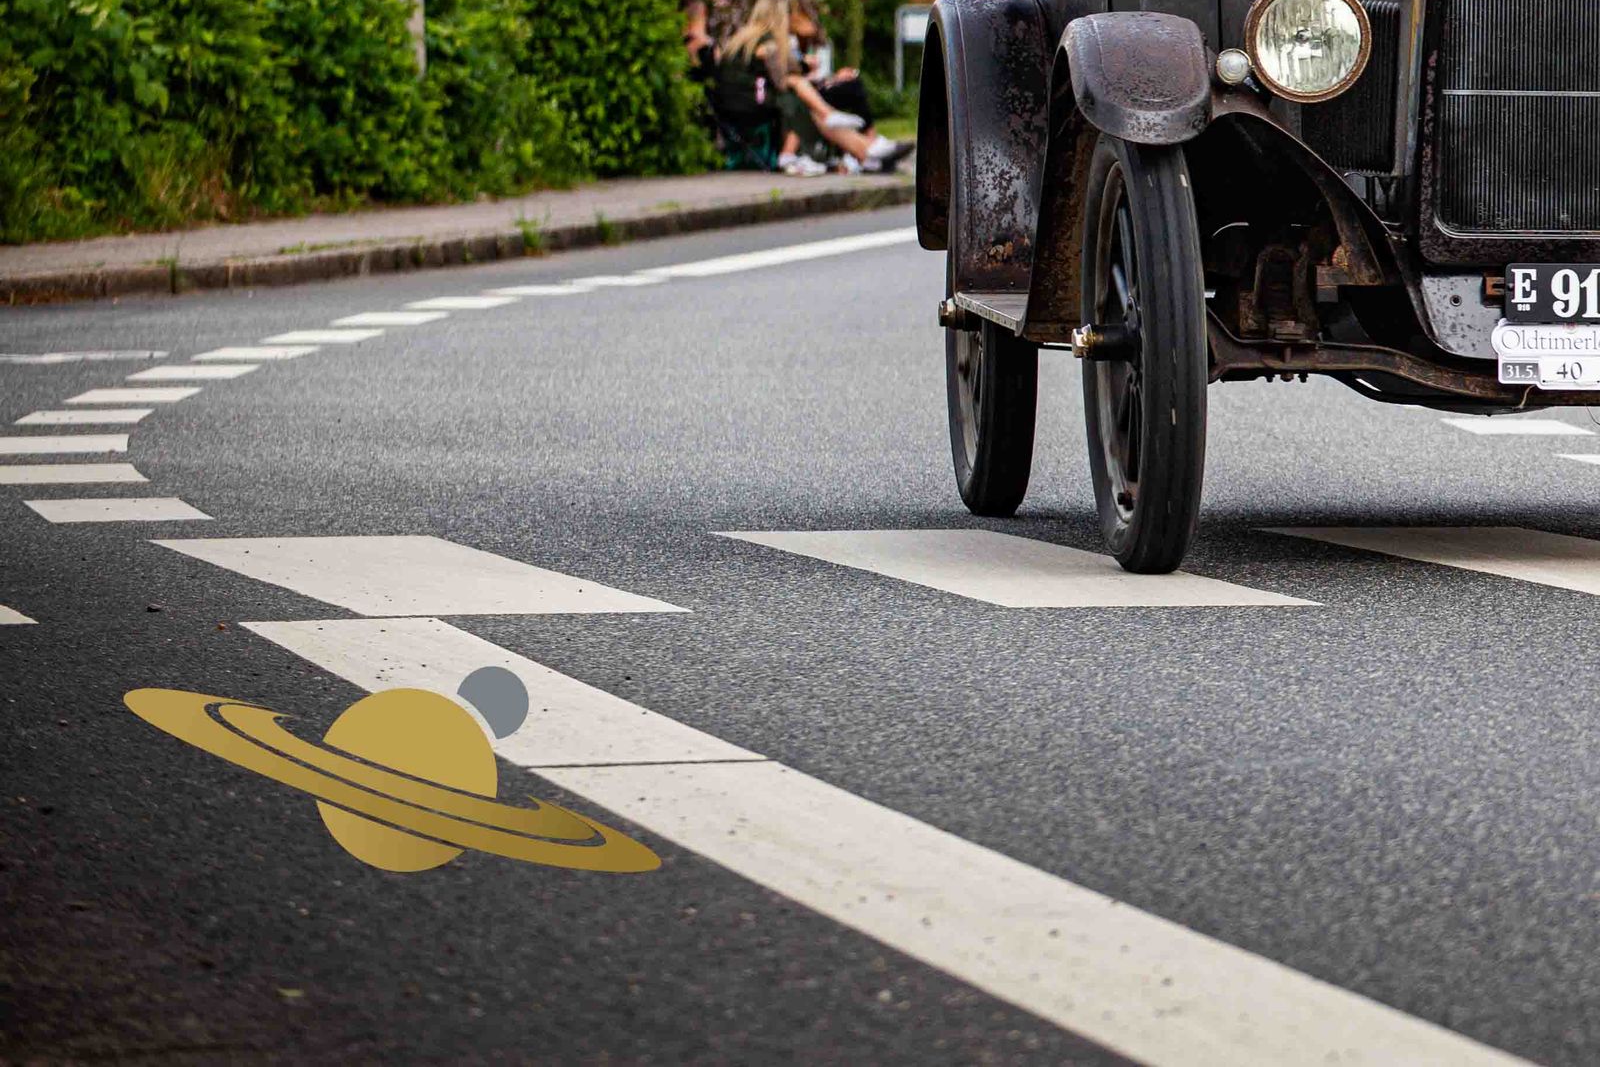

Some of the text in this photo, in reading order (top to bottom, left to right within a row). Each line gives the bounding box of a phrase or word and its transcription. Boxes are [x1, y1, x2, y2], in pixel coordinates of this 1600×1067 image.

[1511, 269, 1537, 303] E
[1506, 365, 1537, 379] 31.5.
[1556, 362, 1583, 380] 40
